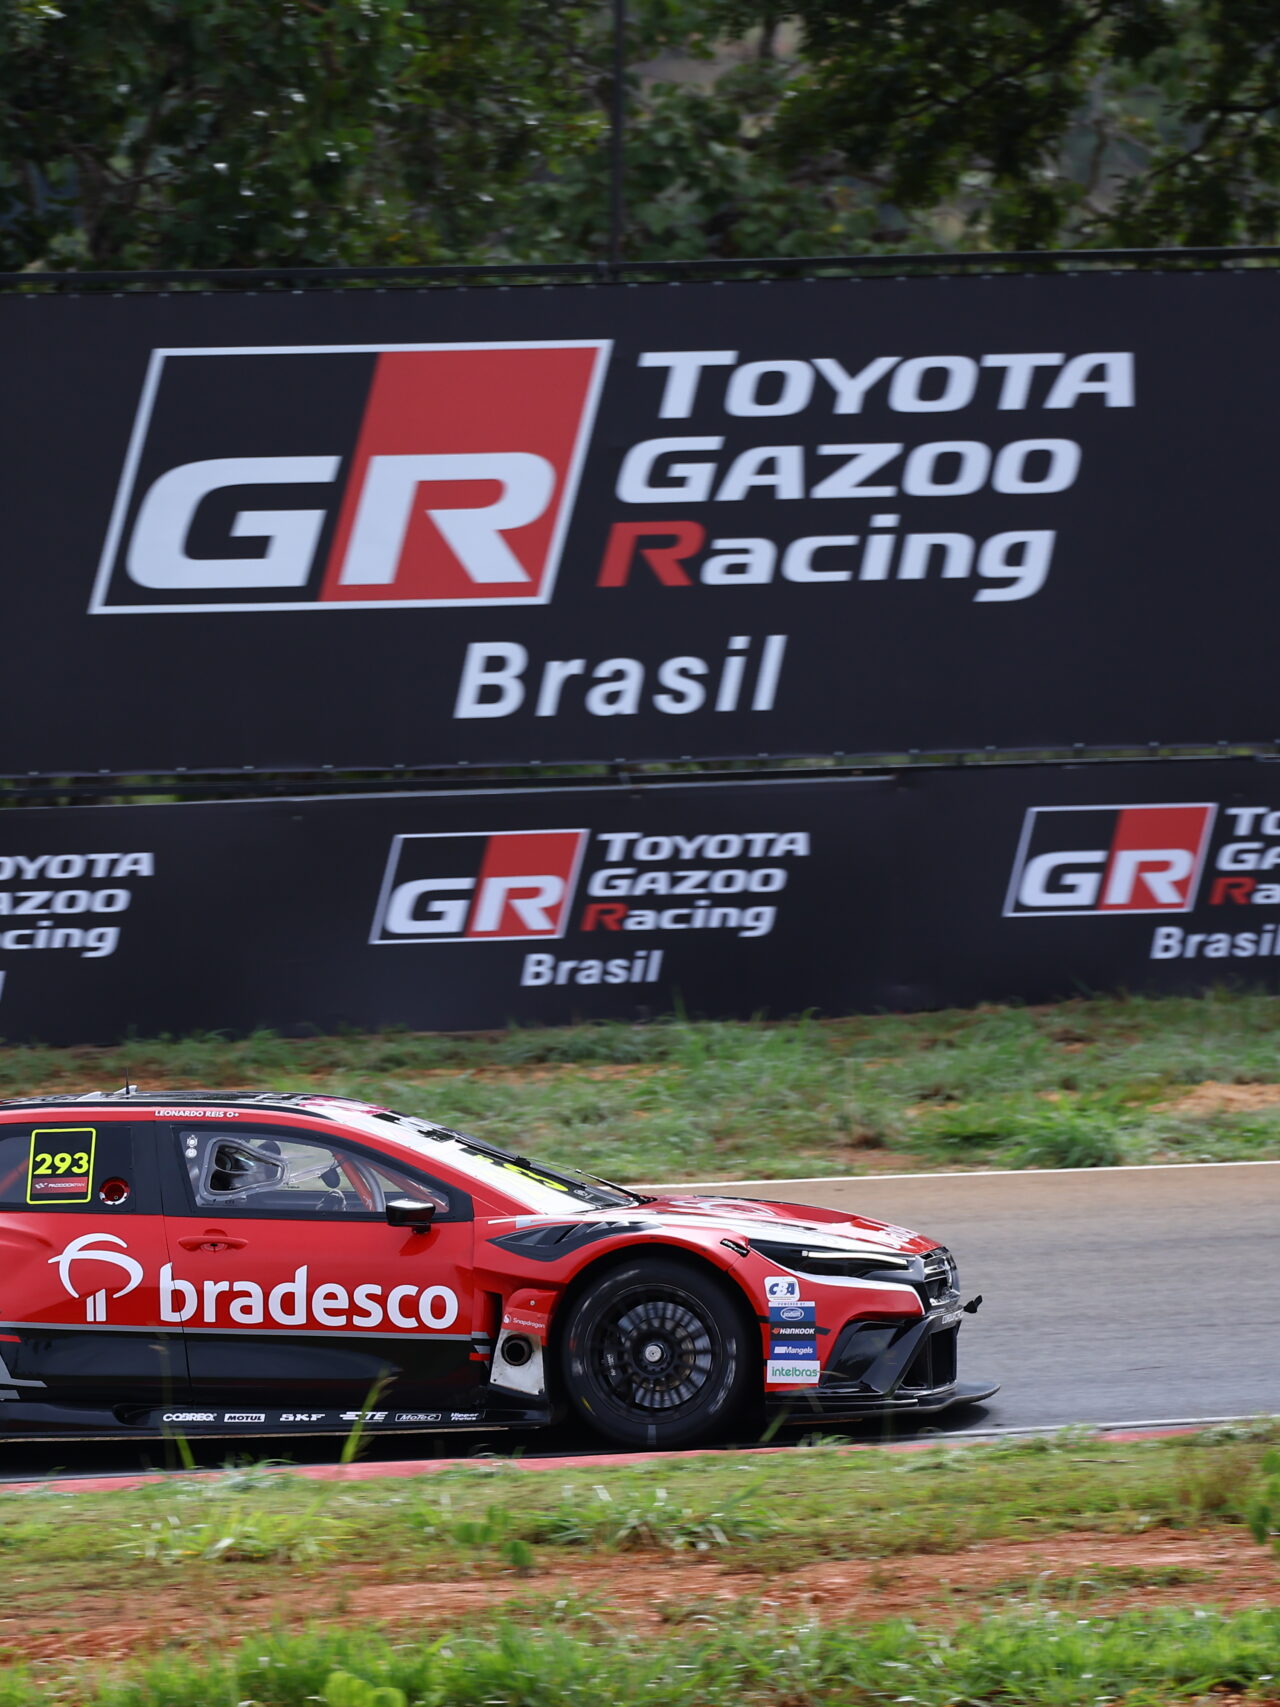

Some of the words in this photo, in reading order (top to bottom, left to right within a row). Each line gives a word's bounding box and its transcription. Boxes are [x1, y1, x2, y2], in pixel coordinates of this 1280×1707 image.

[637, 350, 1135, 418] TOYOTA
[615, 436, 1082, 504] GAZOO
[126, 452, 556, 589] GR
[596, 514, 1057, 602] Racing
[453, 635, 788, 718] Brasil
[596, 832, 811, 862] TOYOTA
[586, 868, 788, 897] GAZOO
[1018, 849, 1195, 907] GR
[384, 875, 565, 934] GR
[579, 899, 777, 938] Racing
[521, 950, 664, 987] Brasil
[33, 1152, 89, 1174] 293
[159, 1262, 459, 1329] bradesco
[513, 1318, 546, 1329] Snapdragon
[772, 1366, 818, 1377] intelbras
[226, 1413, 262, 1421] MOTUL
[279, 1413, 326, 1422] SKF
